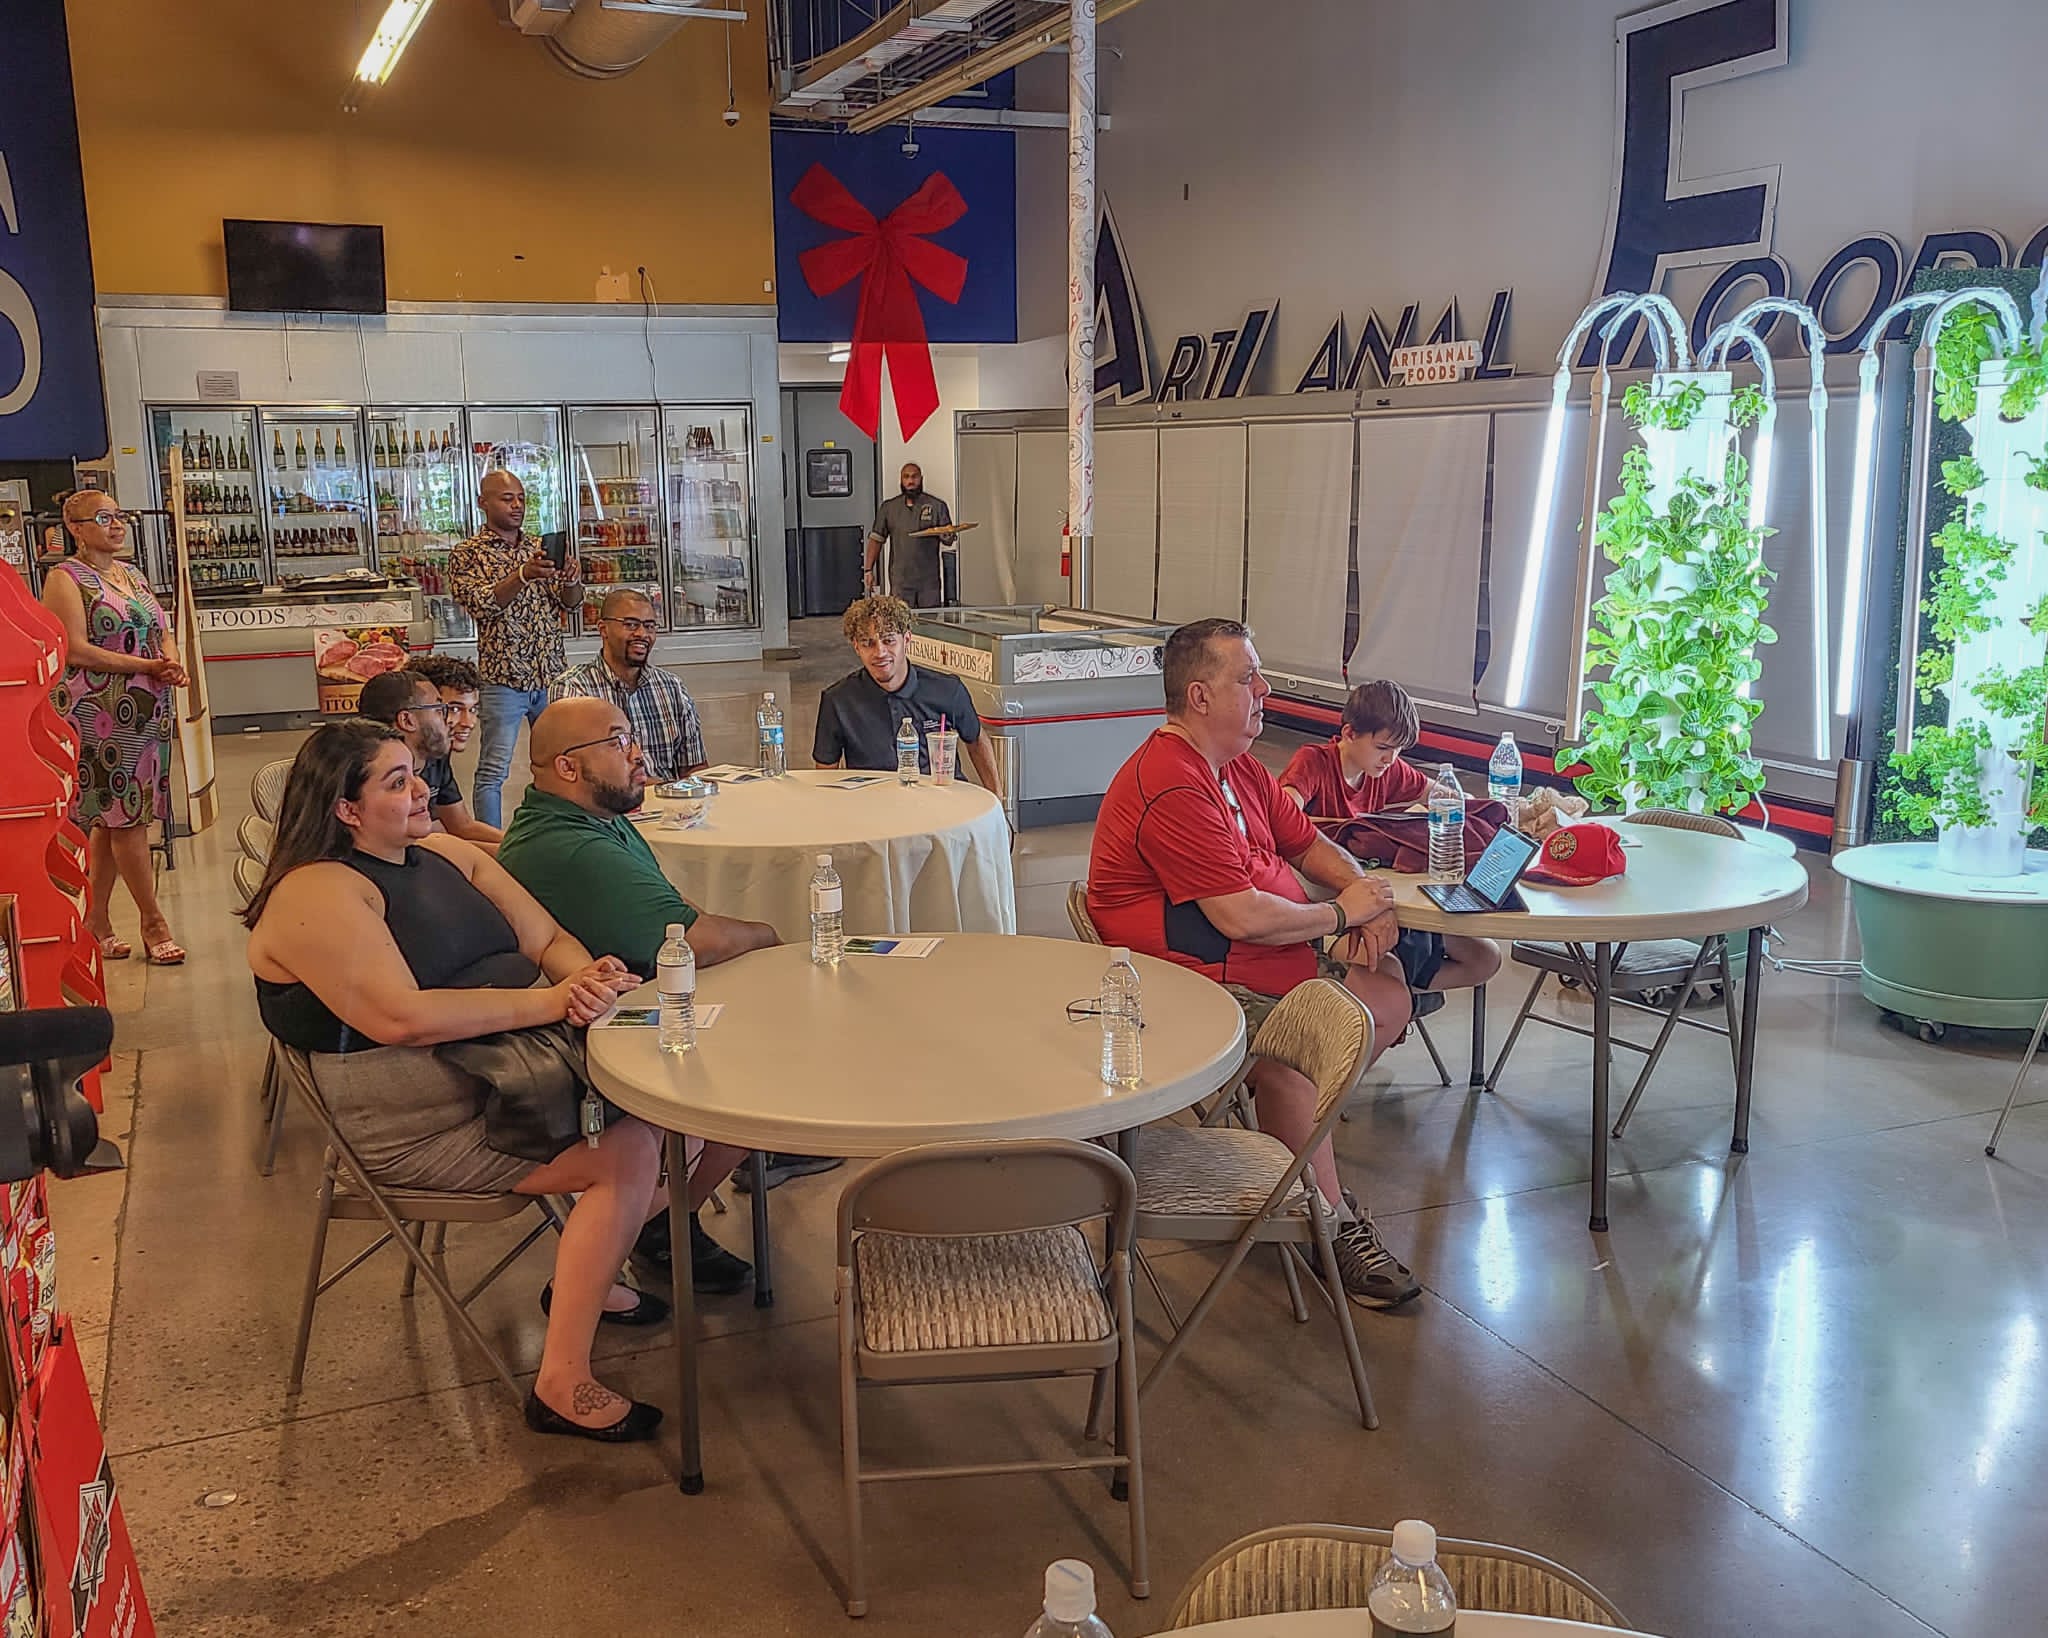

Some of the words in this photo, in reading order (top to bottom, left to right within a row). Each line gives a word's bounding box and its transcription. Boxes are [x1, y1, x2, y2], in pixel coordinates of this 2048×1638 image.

[1392, 345, 1474, 368] ARTISANAL
[1407, 364, 1456, 382] FOODS
[210, 608, 286, 627] FOODS
[949, 649, 977, 672] FOODS
